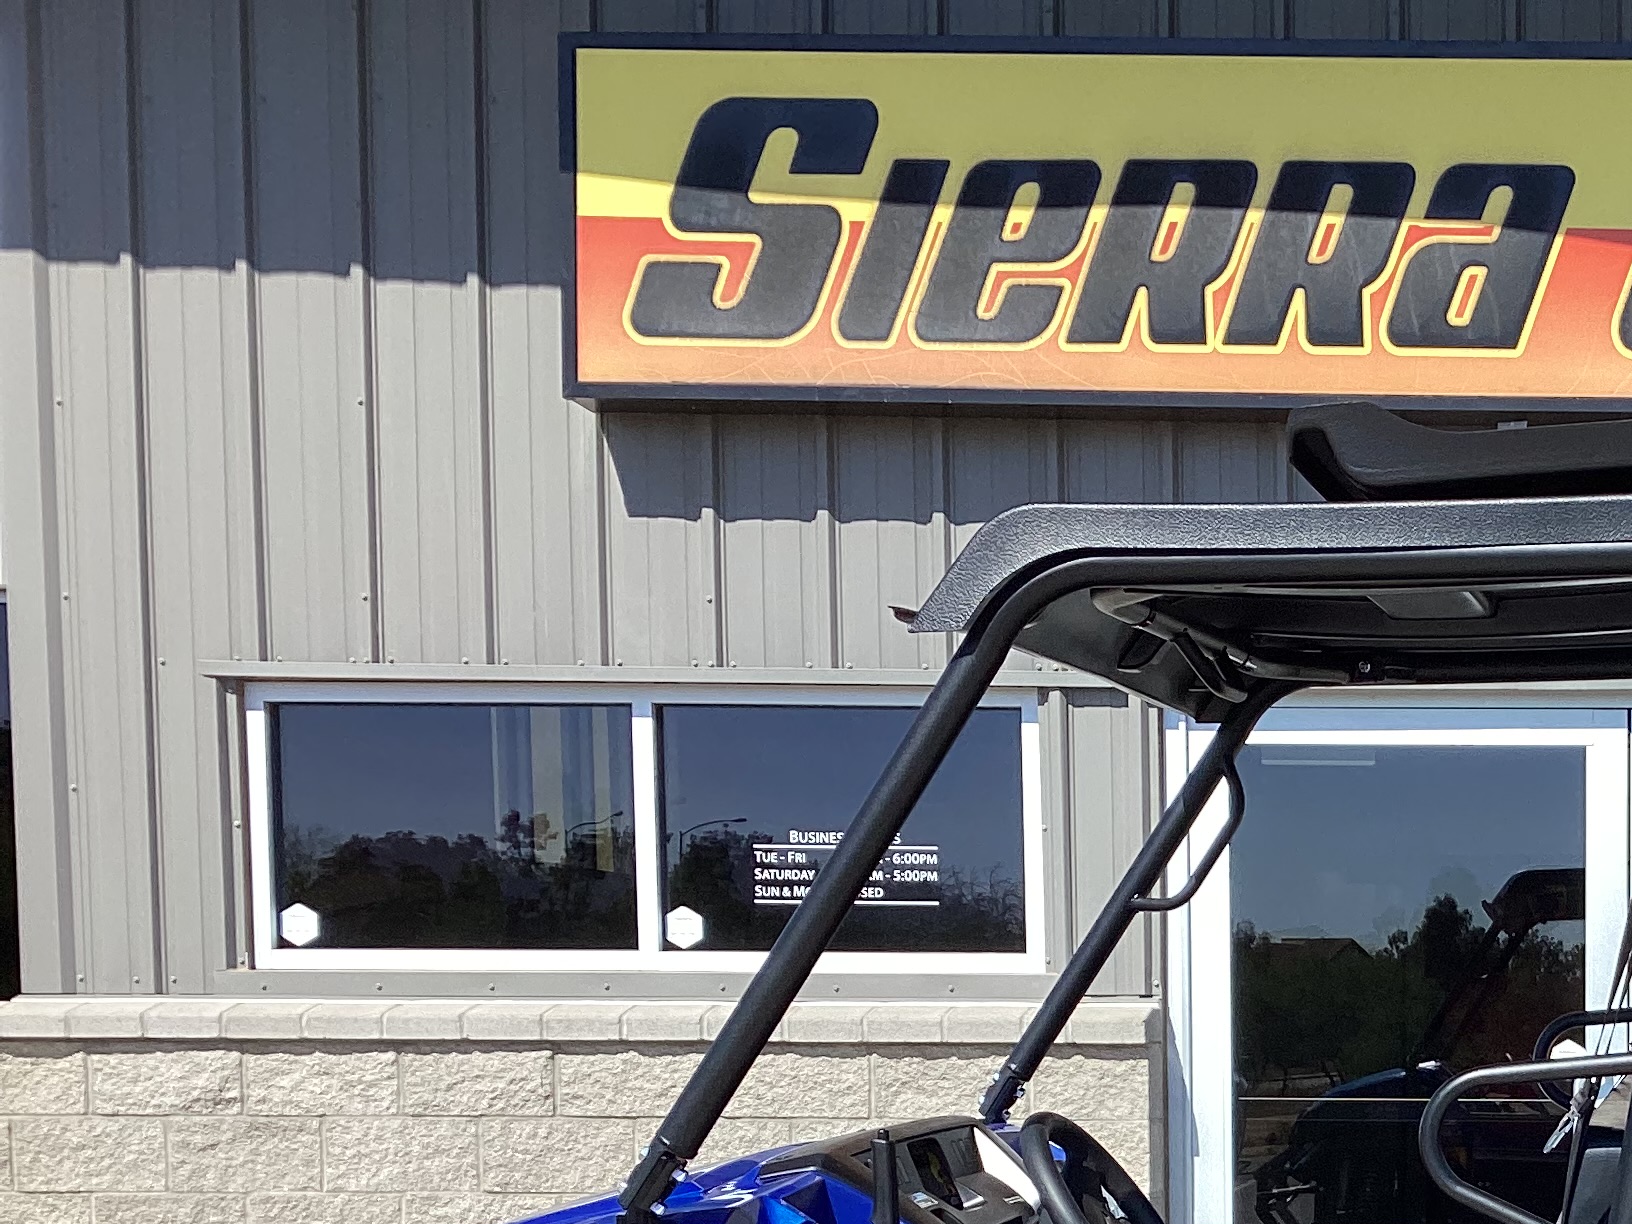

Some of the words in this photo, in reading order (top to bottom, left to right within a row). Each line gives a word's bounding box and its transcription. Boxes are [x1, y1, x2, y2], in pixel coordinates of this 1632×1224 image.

[754, 850, 778, 863] TUE
[787, 851, 806, 863] FRI
[892, 852, 938, 865] 6:00PM
[754, 867, 816, 880] SATURDAY
[892, 869, 938, 882] 5:00PM
[754, 884, 780, 897] SUN
[782, 886, 791, 897] &
